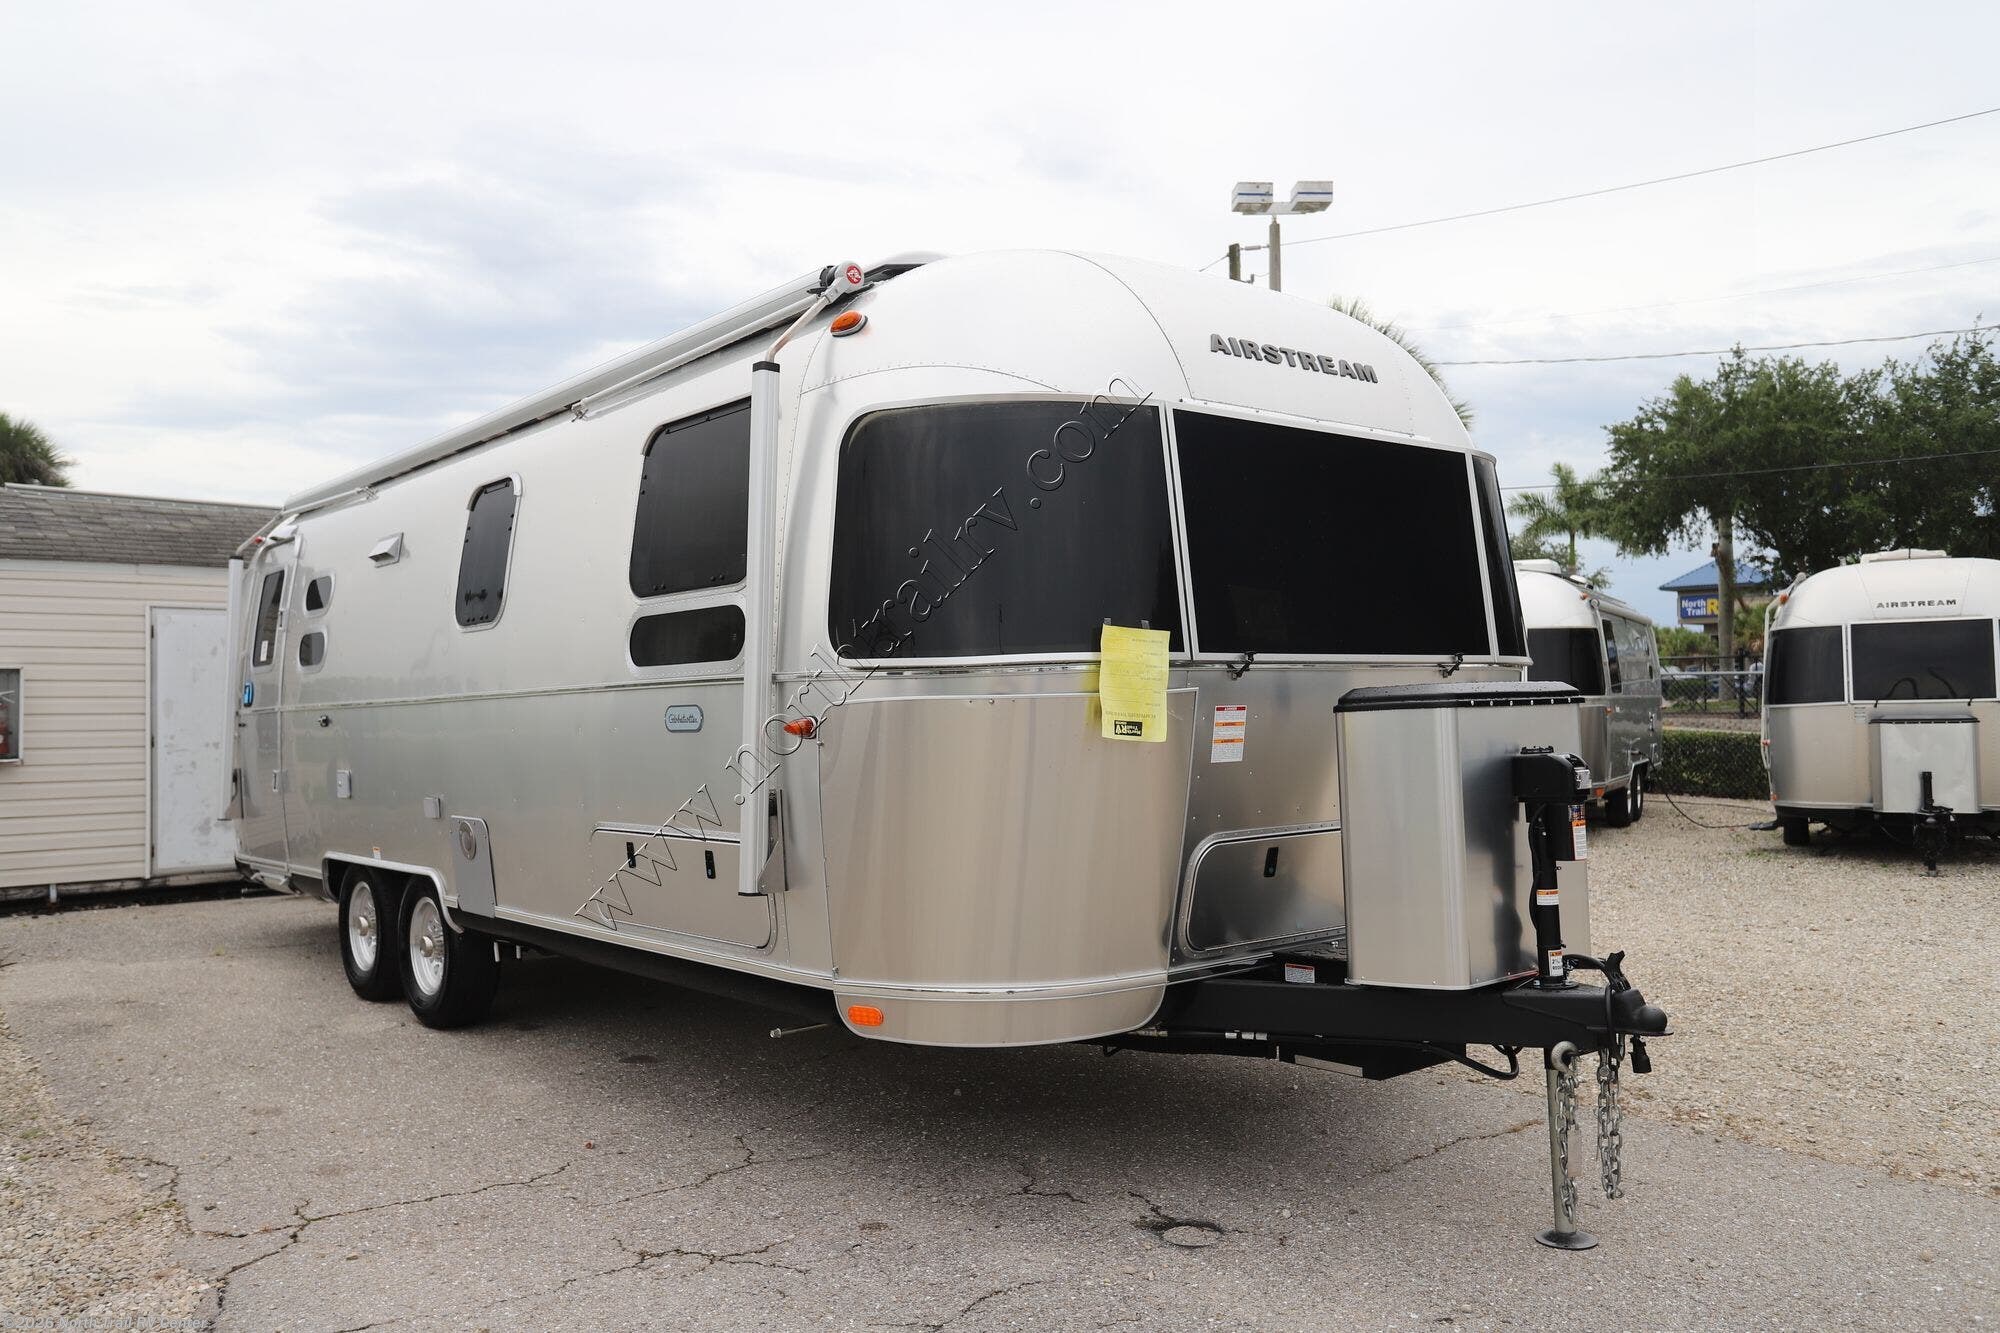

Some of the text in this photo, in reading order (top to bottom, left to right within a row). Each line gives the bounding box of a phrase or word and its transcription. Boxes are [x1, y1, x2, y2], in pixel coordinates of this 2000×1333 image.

[1210, 333, 1379, 384] AIRSTREAM
[1682, 599, 1706, 608] North
[1876, 599, 1957, 609] AIRSTREAM
[1687, 607, 1706, 616] Trail
